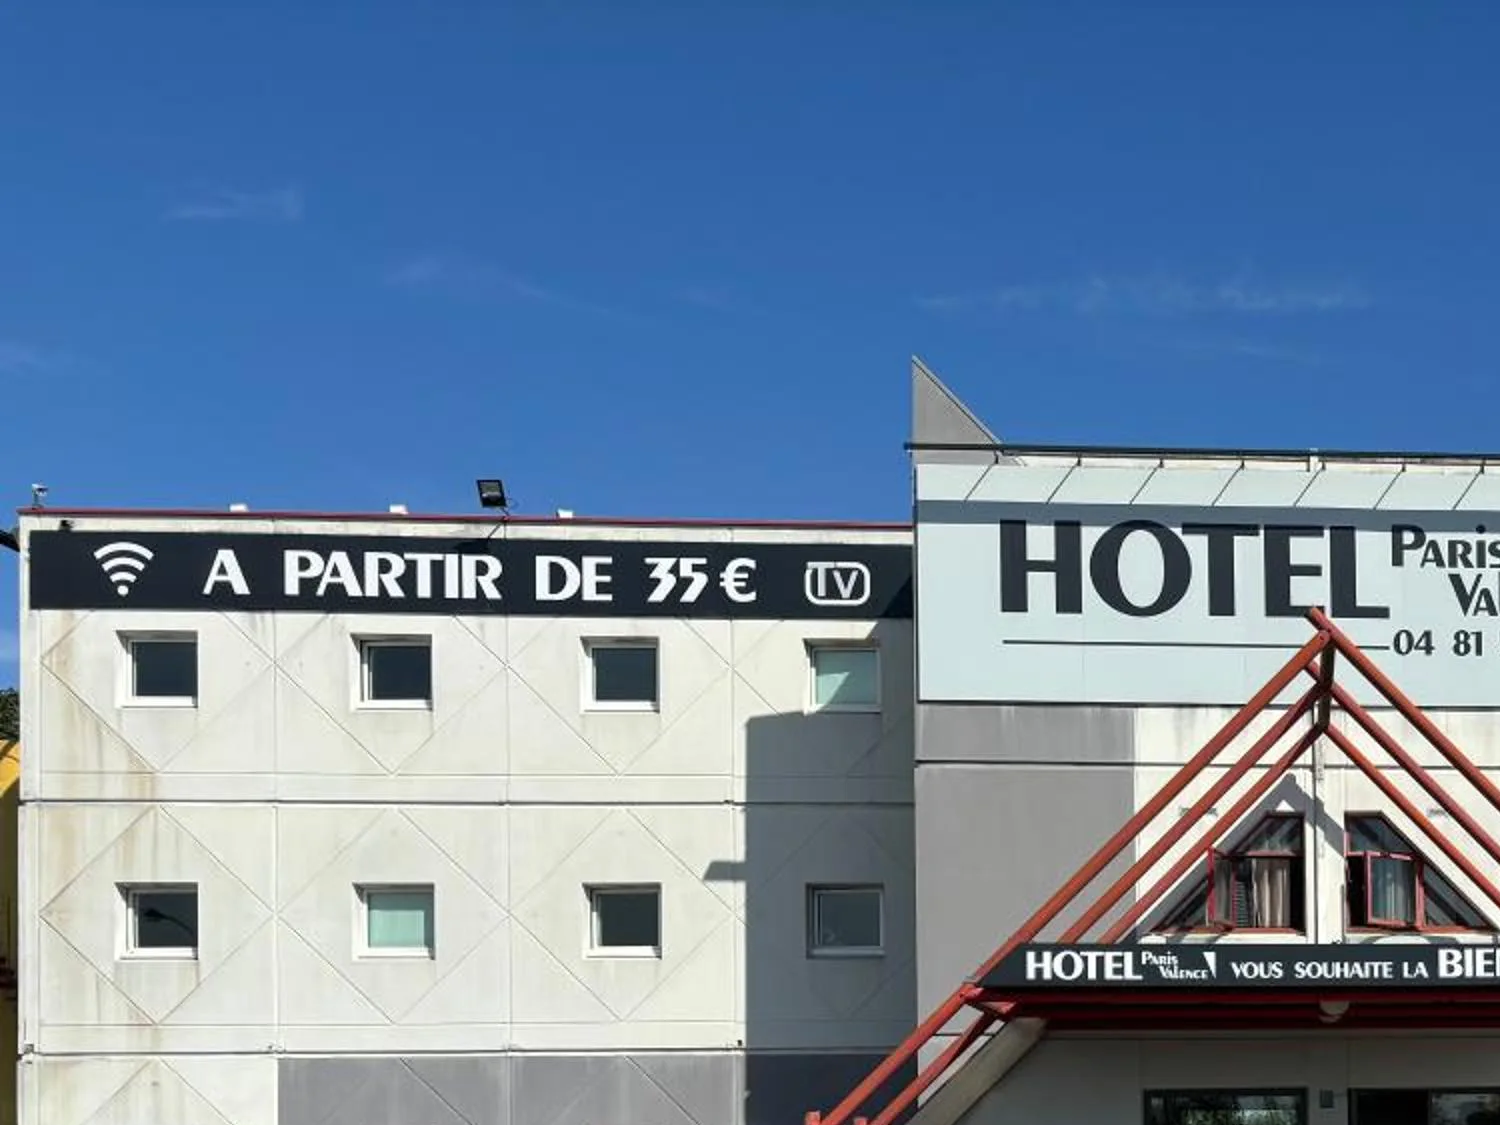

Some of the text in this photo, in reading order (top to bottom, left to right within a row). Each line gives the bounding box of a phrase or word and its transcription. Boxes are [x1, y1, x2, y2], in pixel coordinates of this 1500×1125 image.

[203, 549, 251, 595] A
[284, 549, 502, 599] PARTIR
[535, 555, 613, 601] DE
[806, 561, 860, 600] TV
[1000, 519, 1390, 618] HOTEL
[1393, 629, 1434, 656] 04
[1453, 631, 1483, 657] 81
[1026, 950, 1143, 980] HOTEL
[1231, 961, 1283, 979] VOUS
[1294, 961, 1393, 979] SOUHAITE
[1403, 961, 1429, 979] LA
